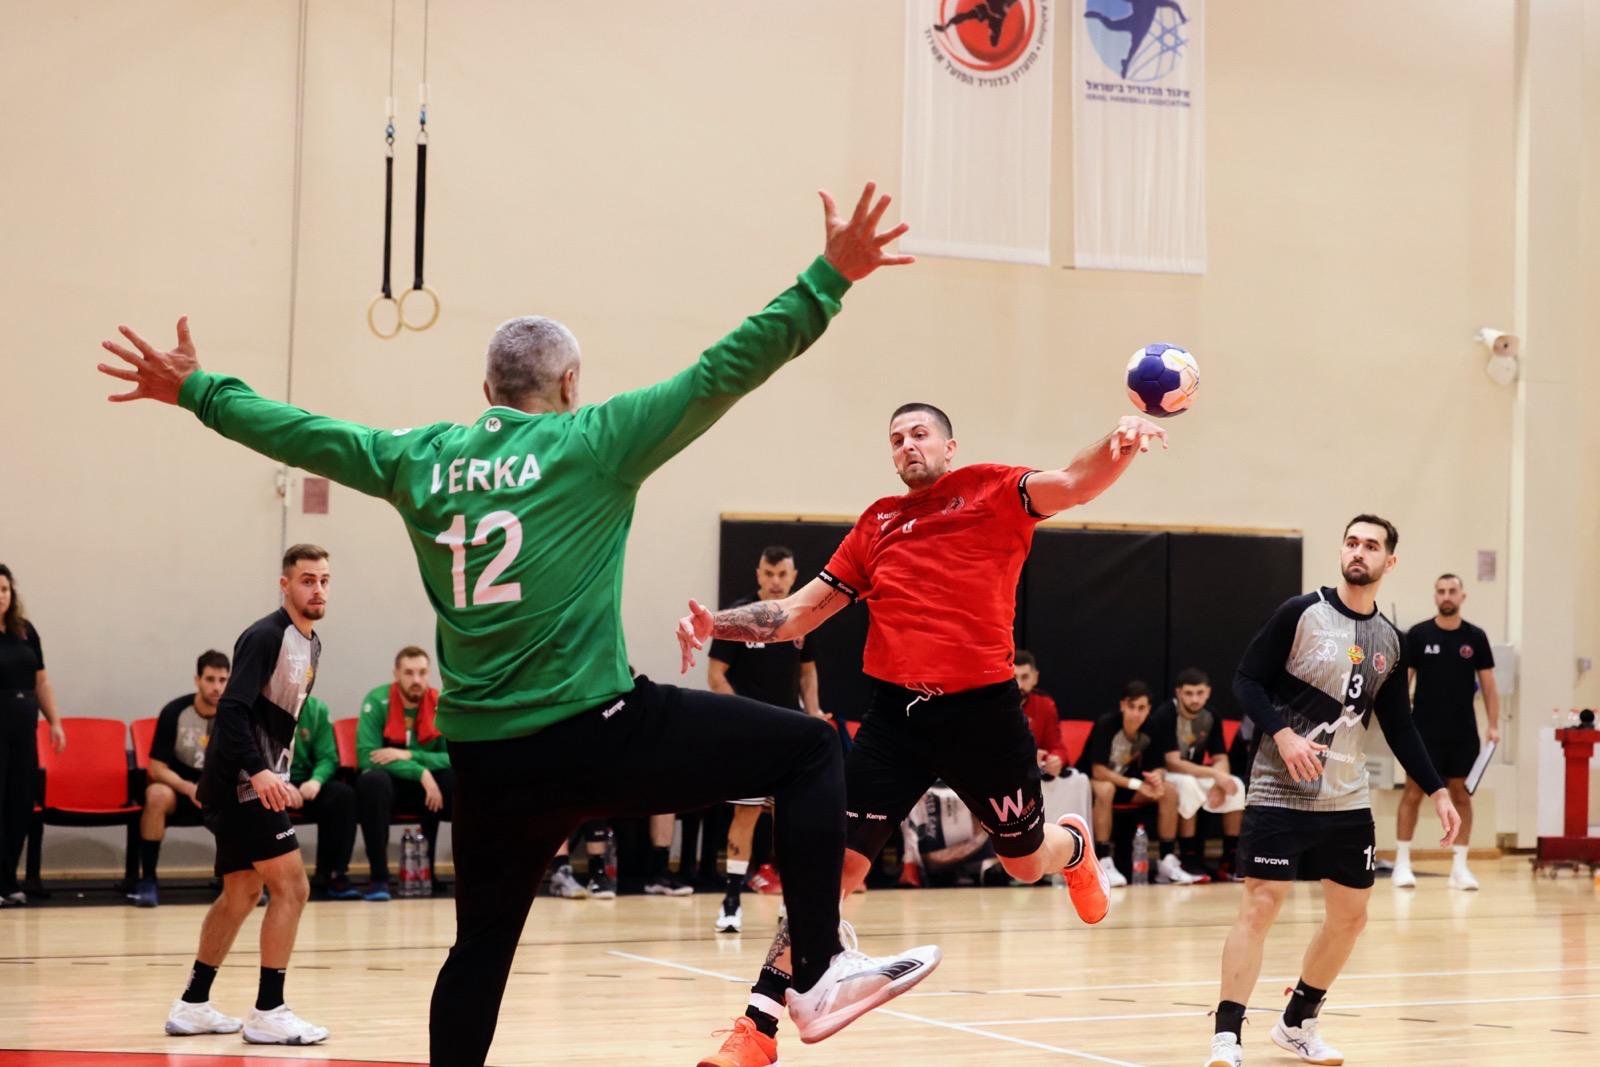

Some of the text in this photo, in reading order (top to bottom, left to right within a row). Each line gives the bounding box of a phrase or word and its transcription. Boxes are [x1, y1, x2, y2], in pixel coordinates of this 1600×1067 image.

[435, 510, 523, 609] 12
[1340, 671, 1364, 699] 13
[1254, 856, 1289, 866] GIVOVA
[1363, 844, 1376, 872] 1
